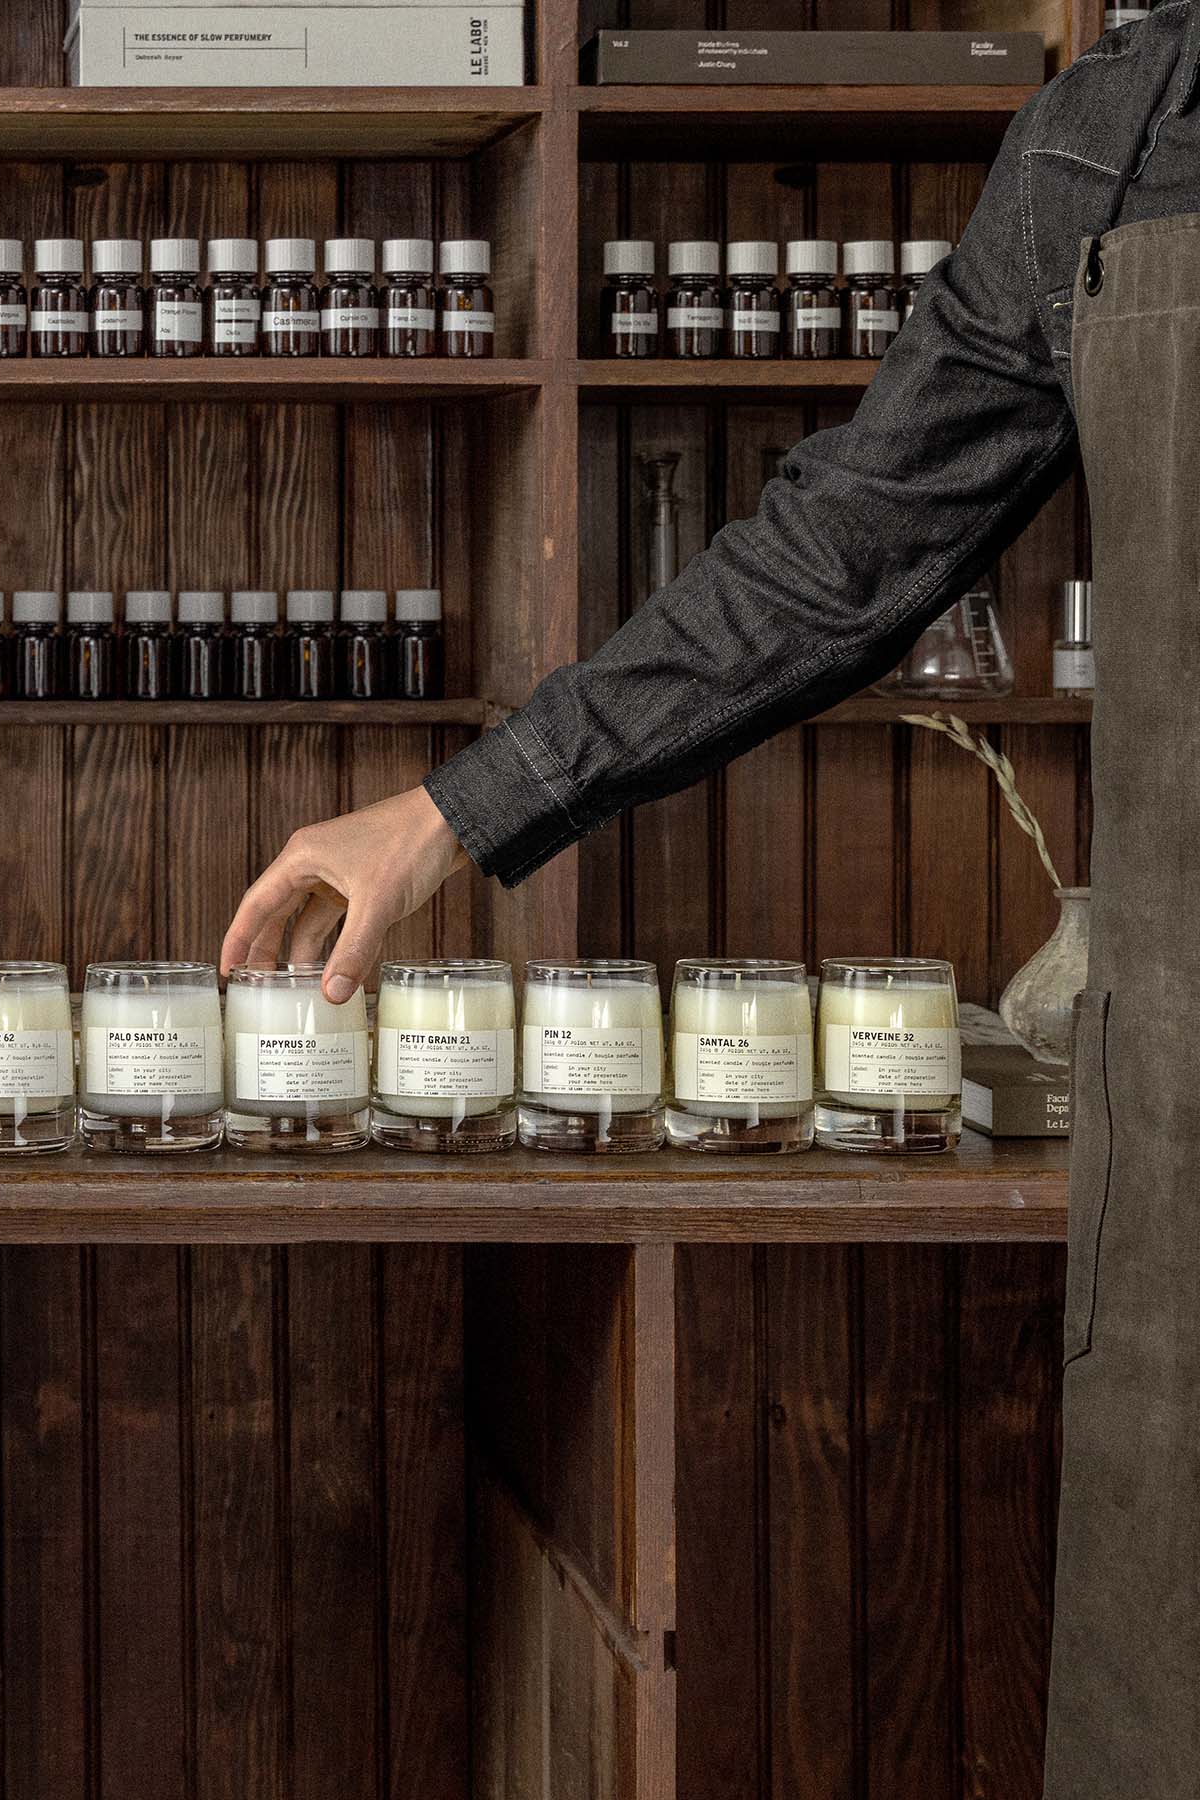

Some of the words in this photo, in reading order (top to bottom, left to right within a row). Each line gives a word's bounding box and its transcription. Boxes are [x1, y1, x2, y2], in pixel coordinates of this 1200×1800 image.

[470, 58, 482, 75] LE
[4, 1034, 14, 1042] 62
[110, 1033, 131, 1041] PALO
[134, 1033, 164, 1041] SANTO
[168, 1033, 177, 1041] 14
[545, 1030, 558, 1038] PIN
[853, 1032, 900, 1041] VERVEINE
[401, 1034, 425, 1043] PETIT
[428, 1036, 457, 1044] GRAIN
[460, 1036, 470, 1044] 21
[700, 1038, 735, 1046] SANTAL
[261, 1040, 303, 1048] PAPYRUS
[306, 1040, 316, 1048] 20
[1047, 1120, 1058, 1129] Le
